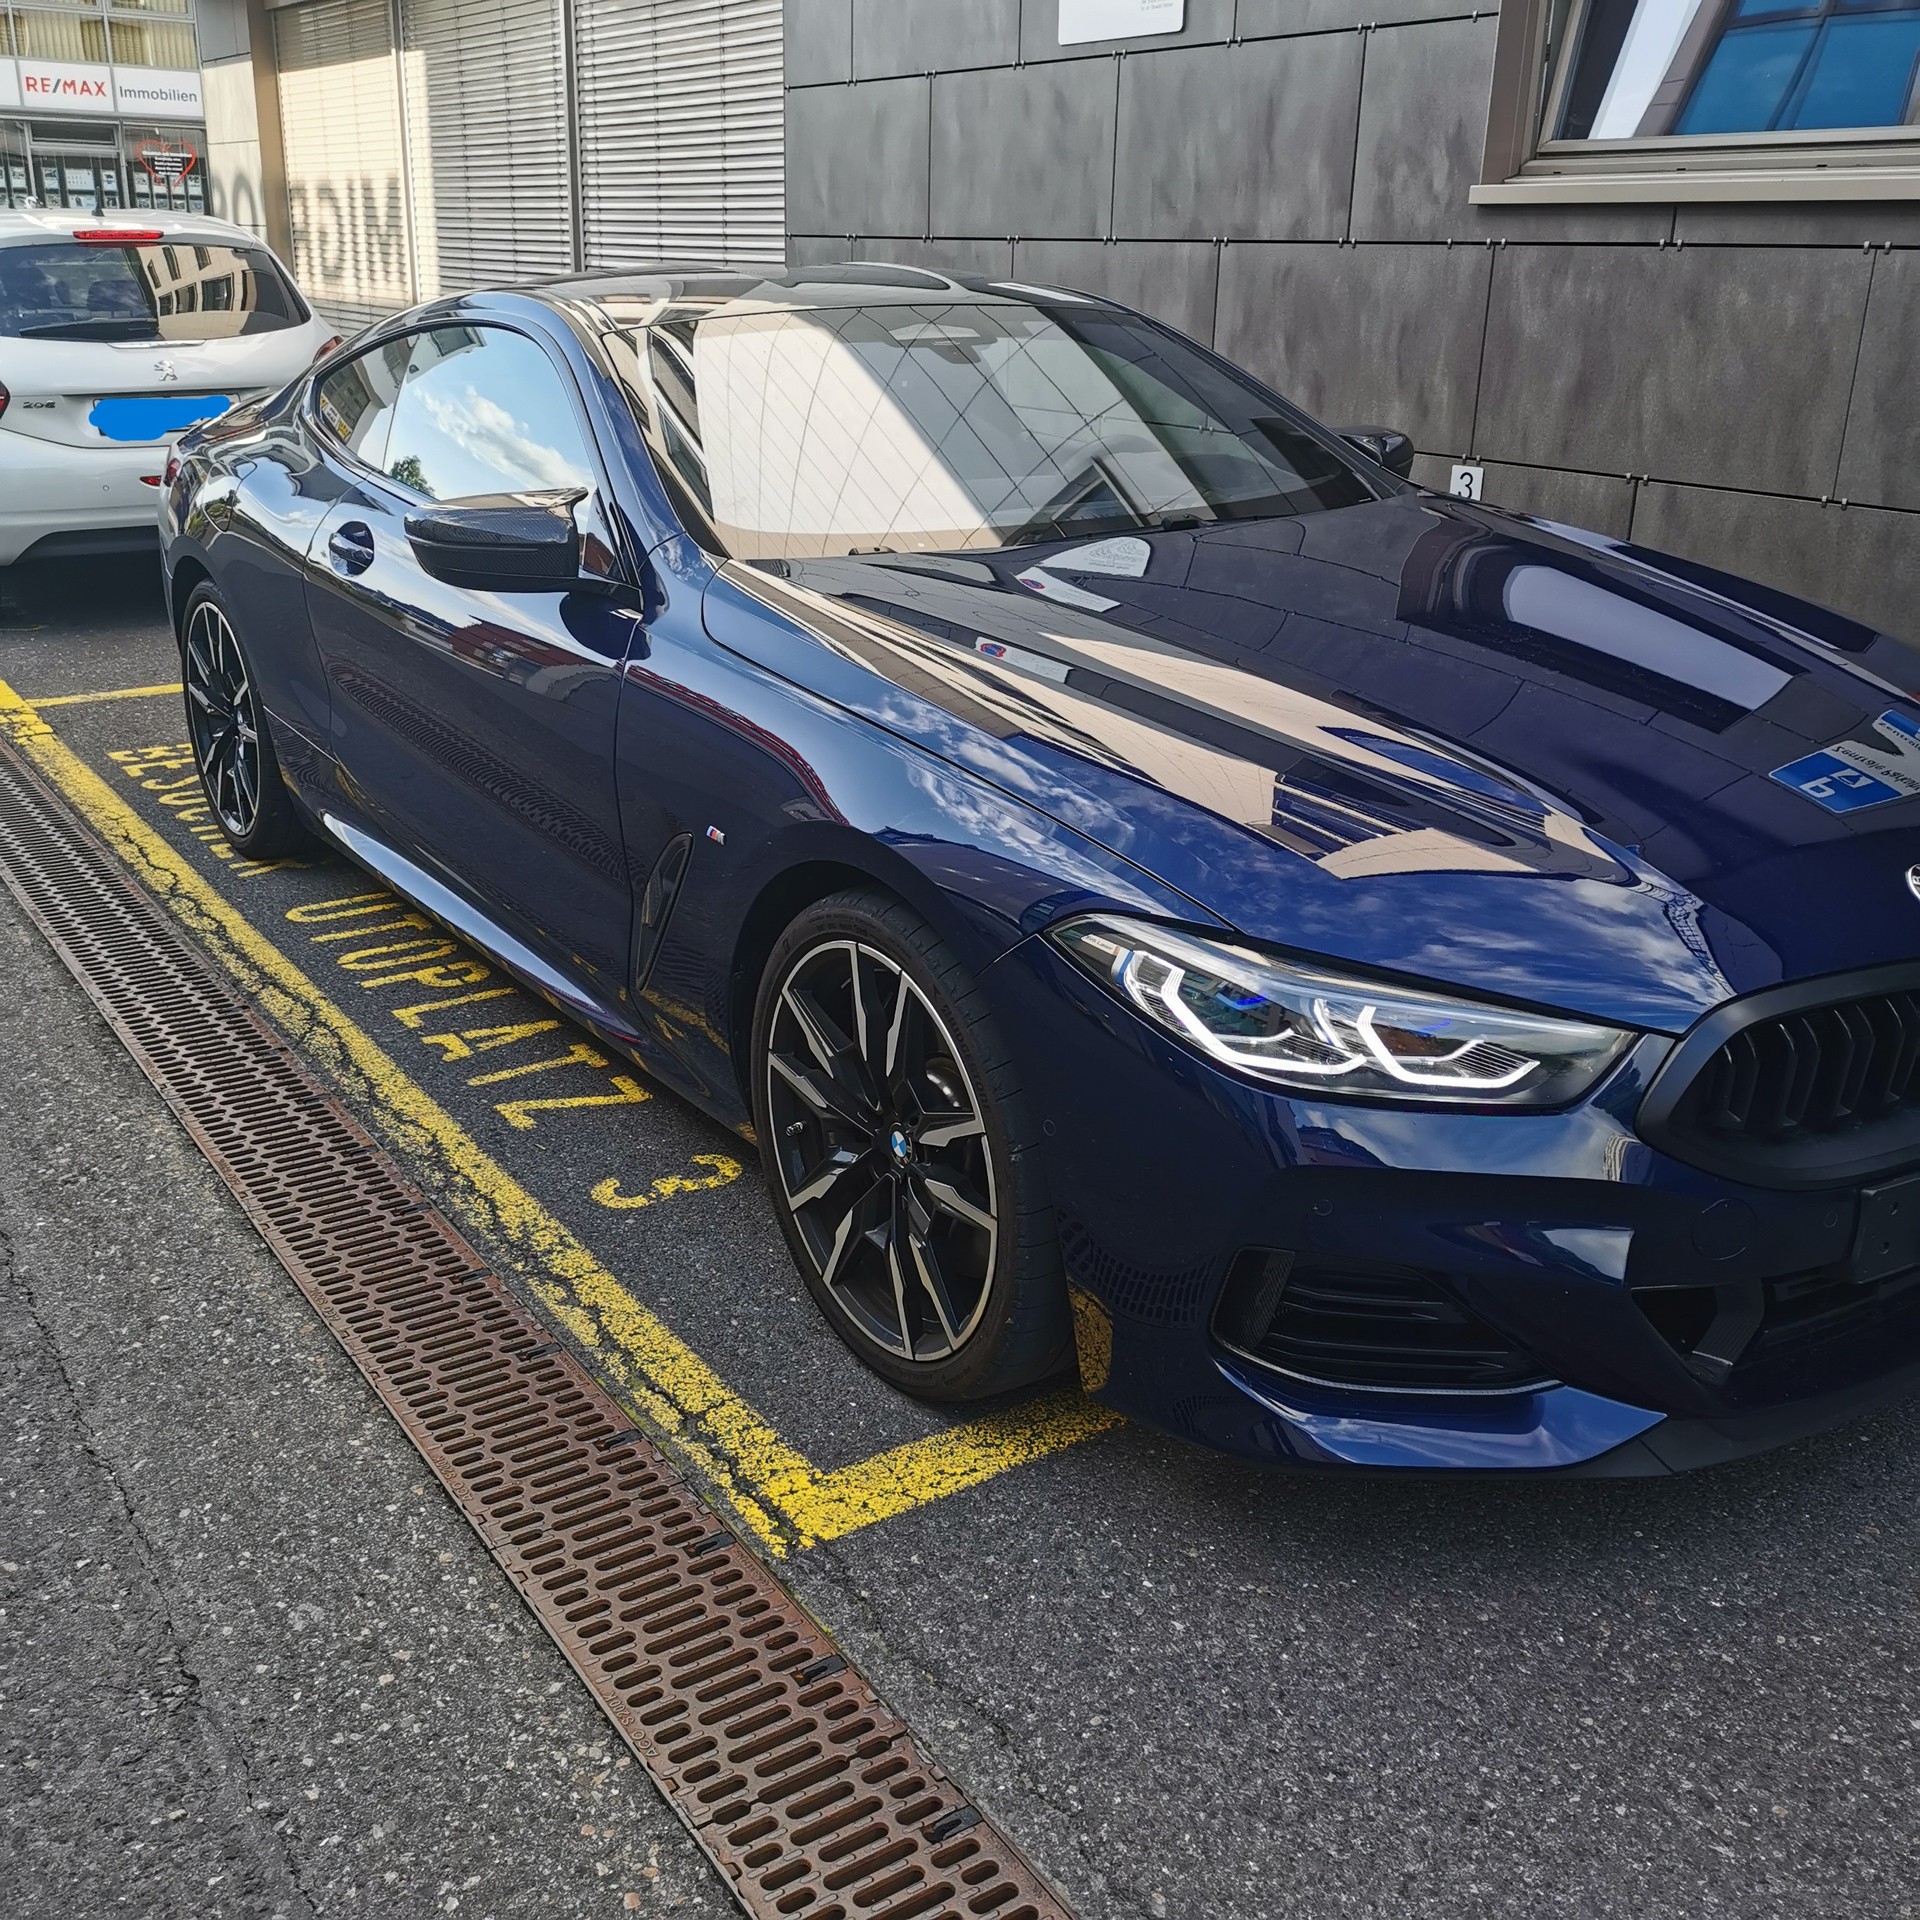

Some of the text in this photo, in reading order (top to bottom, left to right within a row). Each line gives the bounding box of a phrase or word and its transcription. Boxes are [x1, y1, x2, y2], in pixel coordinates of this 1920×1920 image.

[25, 76, 198, 103] RE/MAX Immobilien
[1458, 472, 1473, 499] 3
[107, 743, 744, 1210] BESUR UTOPLATZ 3
[603, 1691, 660, 1758] ACO S200K
